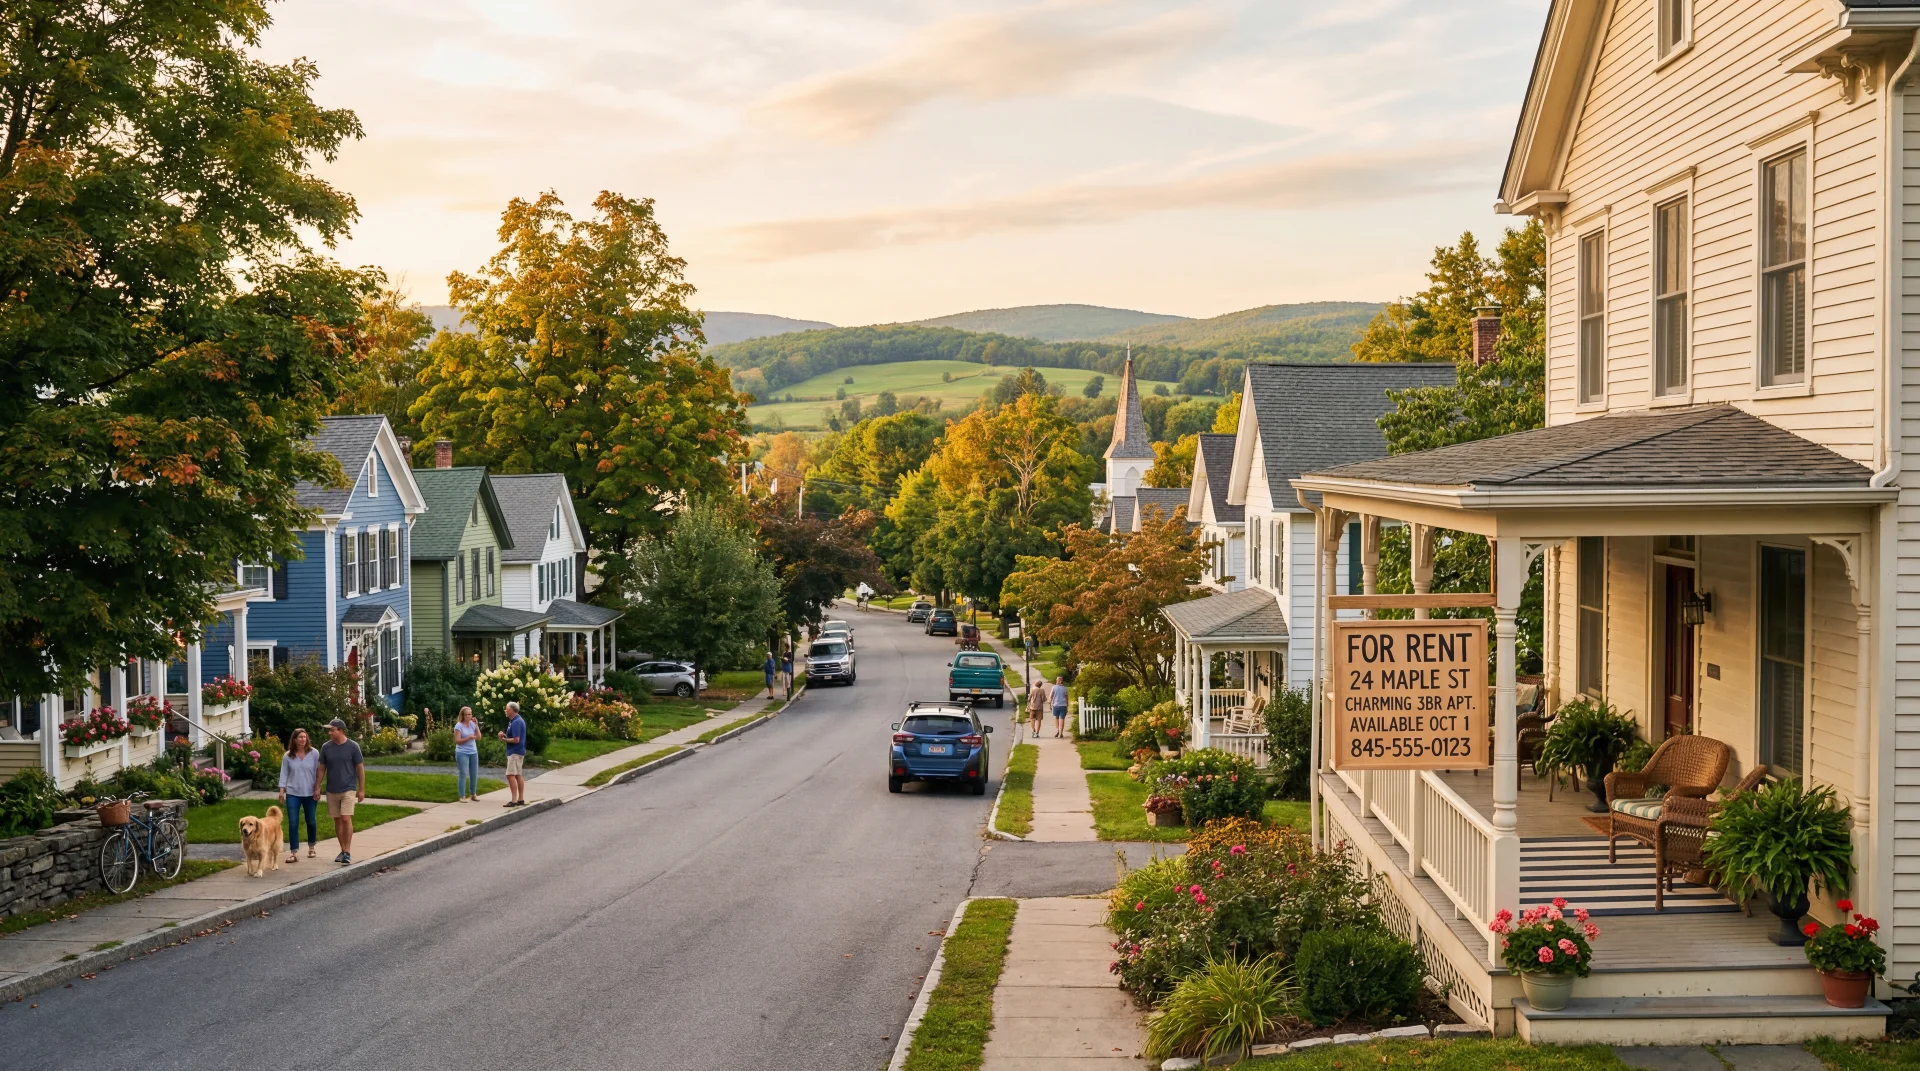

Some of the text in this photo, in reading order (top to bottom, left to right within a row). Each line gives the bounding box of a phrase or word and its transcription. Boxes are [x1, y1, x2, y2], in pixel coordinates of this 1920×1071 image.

[1347, 633, 1472, 663] FOR RENT
[1350, 669, 1470, 690] 24 MAPLE ST
[1345, 695, 1476, 712] CHARMING 3BR APT.
[1350, 715, 1469, 732] AVAILABLE OCT 1
[1350, 737, 1471, 758] 845-555-0123
